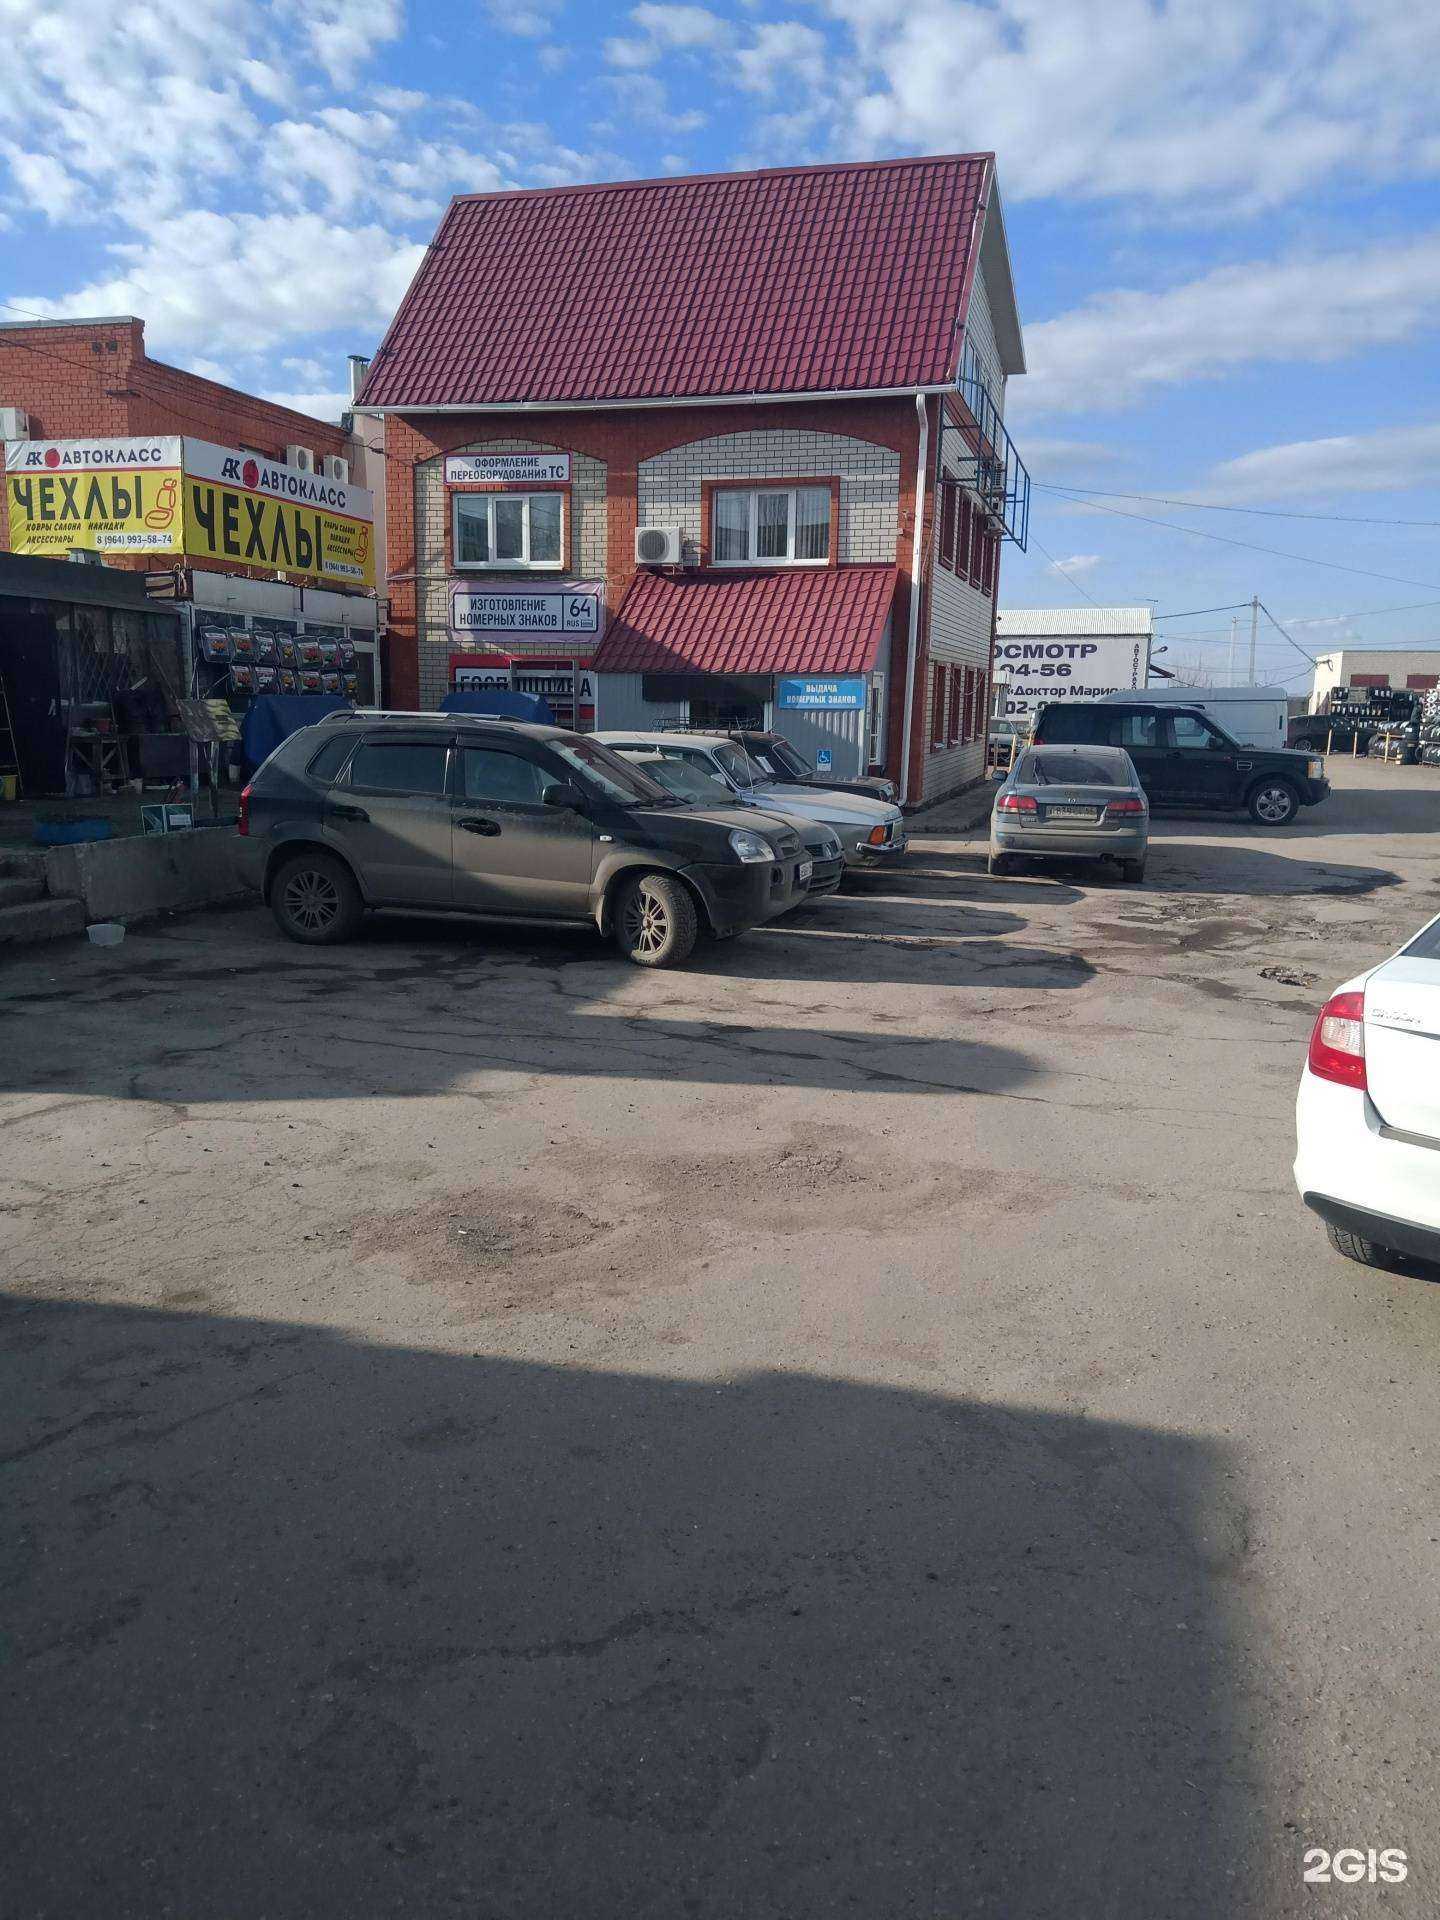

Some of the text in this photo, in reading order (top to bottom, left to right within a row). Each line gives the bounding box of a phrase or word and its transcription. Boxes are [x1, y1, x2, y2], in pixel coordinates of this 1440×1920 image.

[62, 448, 162, 466] АВТОКЛАСС
[474, 457, 540, 468] ОФОРМЛЕНИЕ
[450, 465, 565, 481] ПЕРЕОБОРУДОВАНИЯ ТС
[260, 468, 346, 508] АВТОКЛАСС
[13, 475, 143, 521] ЧЕХЛЫ
[26, 521, 125, 532] КОВРЫ САЛОНА НАКИДКИ
[193, 485, 323, 572] ЧЕХЛЫ
[26, 535, 75, 544] АКСЕССУАРЫ
[96, 535, 102, 545] 8
[104, 534, 125, 546] (964)
[470, 599, 546, 612] ИЗГОТОВЛЕНИЕ
[569, 598, 591, 618] 64
[459, 613, 558, 627] НОМЕРНЫХ ЗНАКОВ
[566, 620, 579, 629] RUS
[805, 684, 838, 694] ВЫДАЧА
[786, 695, 857, 704] НОМЕРНЫХ ЗНАКОВ
